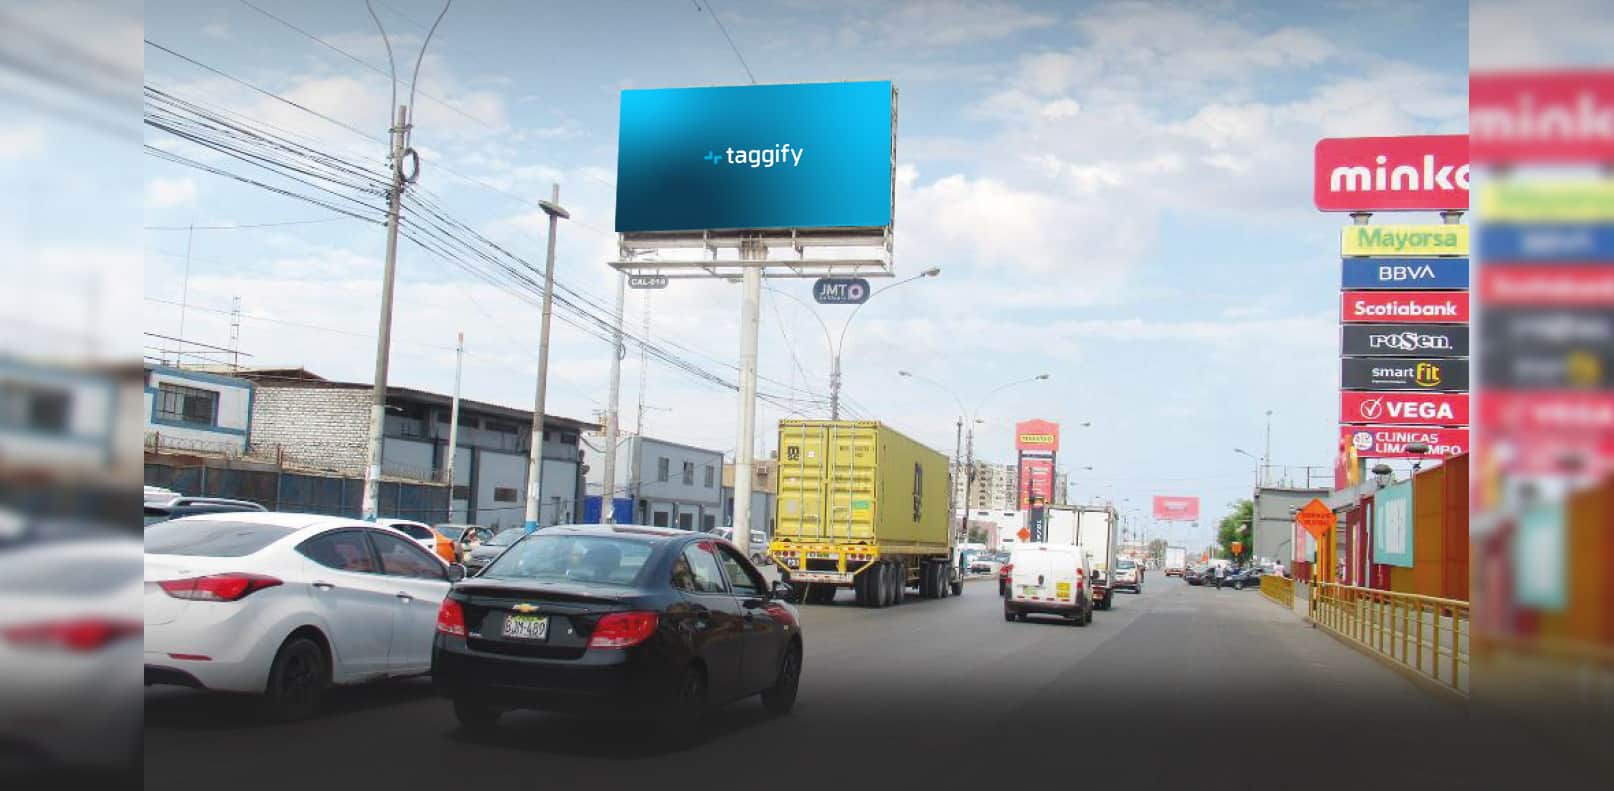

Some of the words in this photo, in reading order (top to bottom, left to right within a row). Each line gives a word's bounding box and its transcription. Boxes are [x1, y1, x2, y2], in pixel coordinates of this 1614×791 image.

[726, 144, 803, 167] taggify
[1358, 226, 1457, 251] Mayorsa
[1379, 265, 1436, 280] BBVA
[820, 283, 848, 296] JMT
[1354, 300, 1457, 316] Scotiabank
[1371, 367, 1415, 378] smart
[1416, 362, 1440, 380] fit
[1386, 402, 1454, 419] VEGA
[1375, 431, 1438, 444] CLINICAS
[1375, 442, 1462, 456] LIMMO
